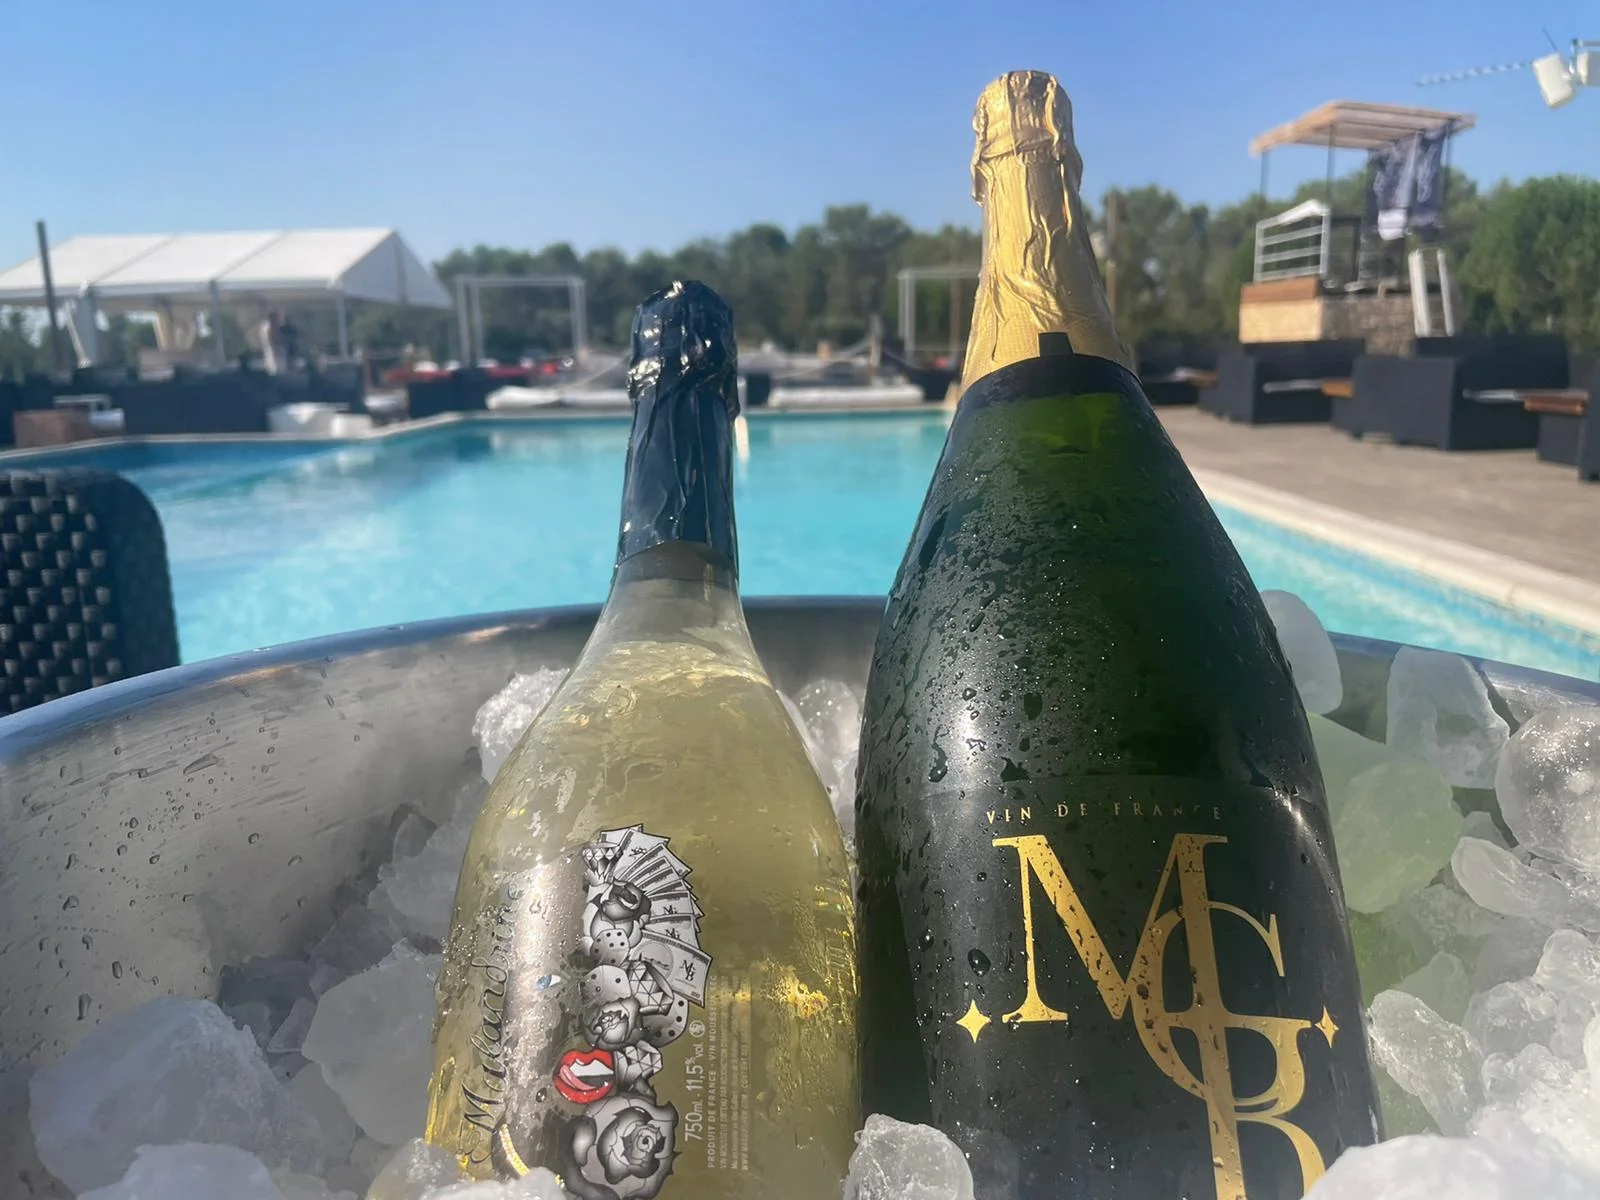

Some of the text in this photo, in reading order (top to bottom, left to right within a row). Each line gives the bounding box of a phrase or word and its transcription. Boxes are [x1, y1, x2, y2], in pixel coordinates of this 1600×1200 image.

[986, 802, 1221, 825] VIN DE FRANCE
[708, 994, 717, 1042] MOUSSEUX
[708, 1045, 717, 1061] VIN
[707, 1070, 716, 1107] FRANCE
[707, 1109, 716, 1123] DE
[707, 1123, 716, 1169] PRODUIT
